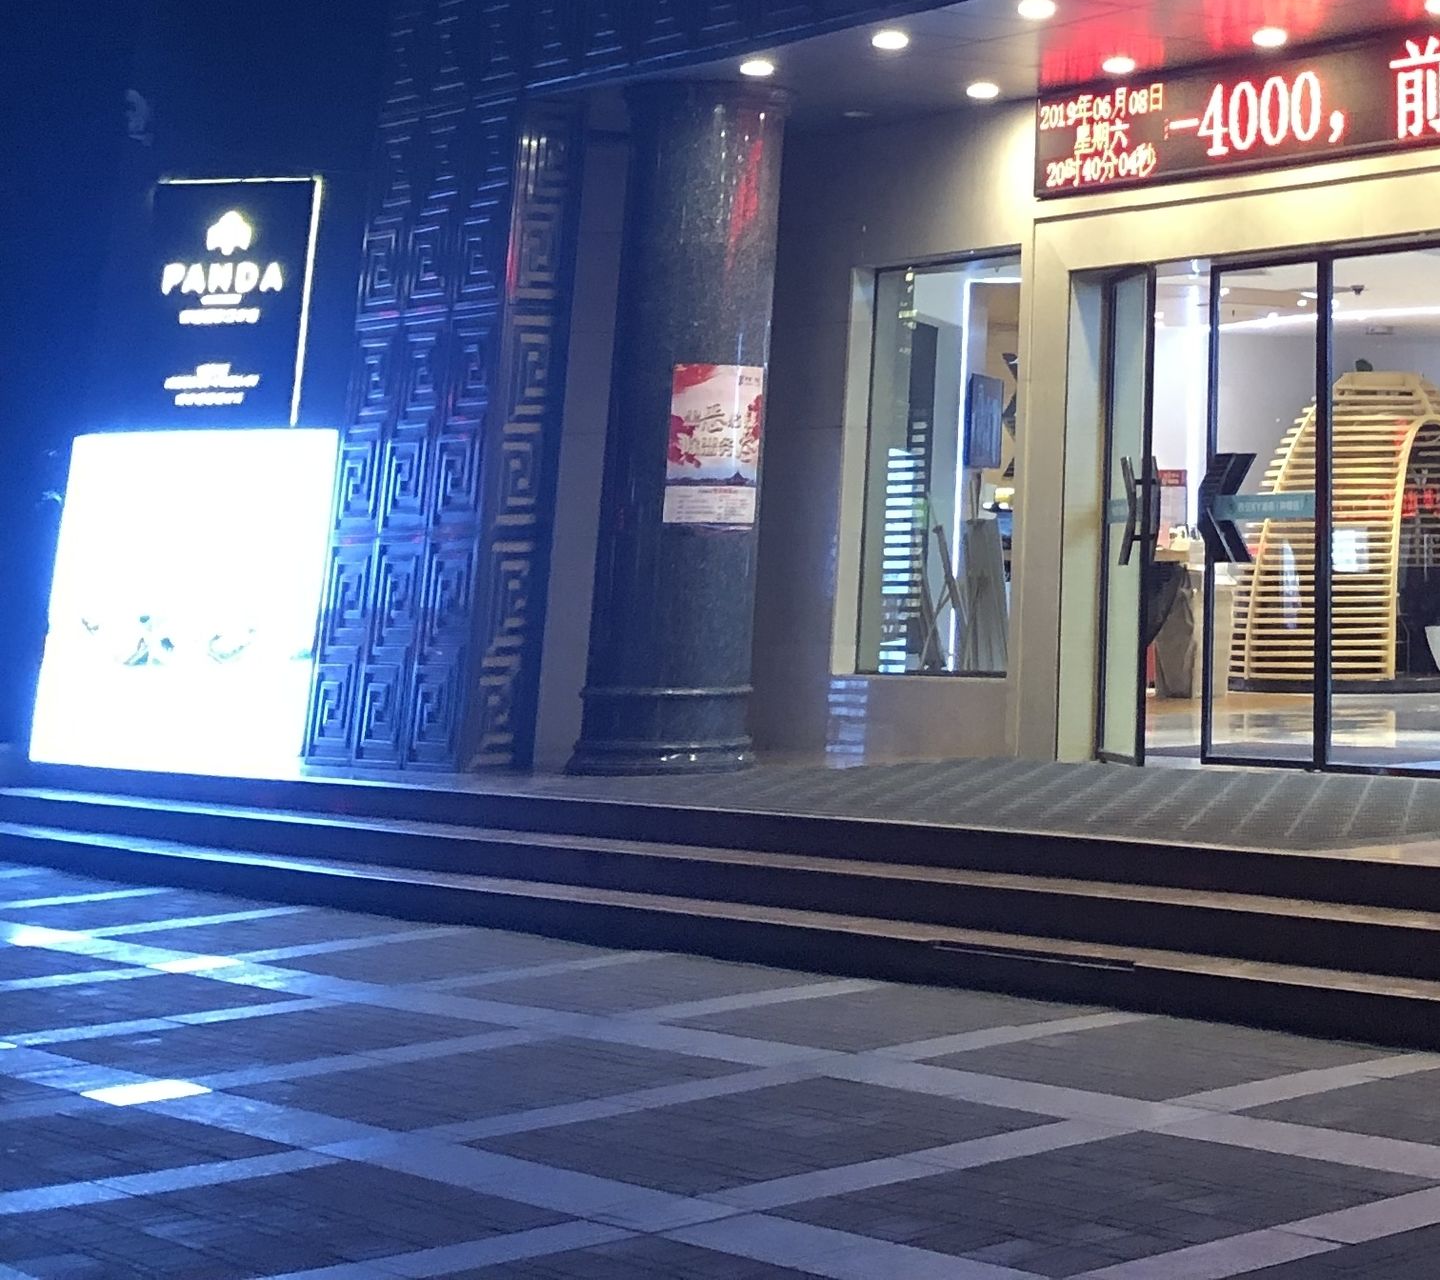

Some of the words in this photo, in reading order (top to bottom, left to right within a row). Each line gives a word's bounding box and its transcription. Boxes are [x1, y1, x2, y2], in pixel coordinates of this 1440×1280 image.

[1039, 82, 1163, 131] 2019年06月08日
[1074, 117, 1130, 155] 星期六
[161, 261, 284, 296] PANDA
